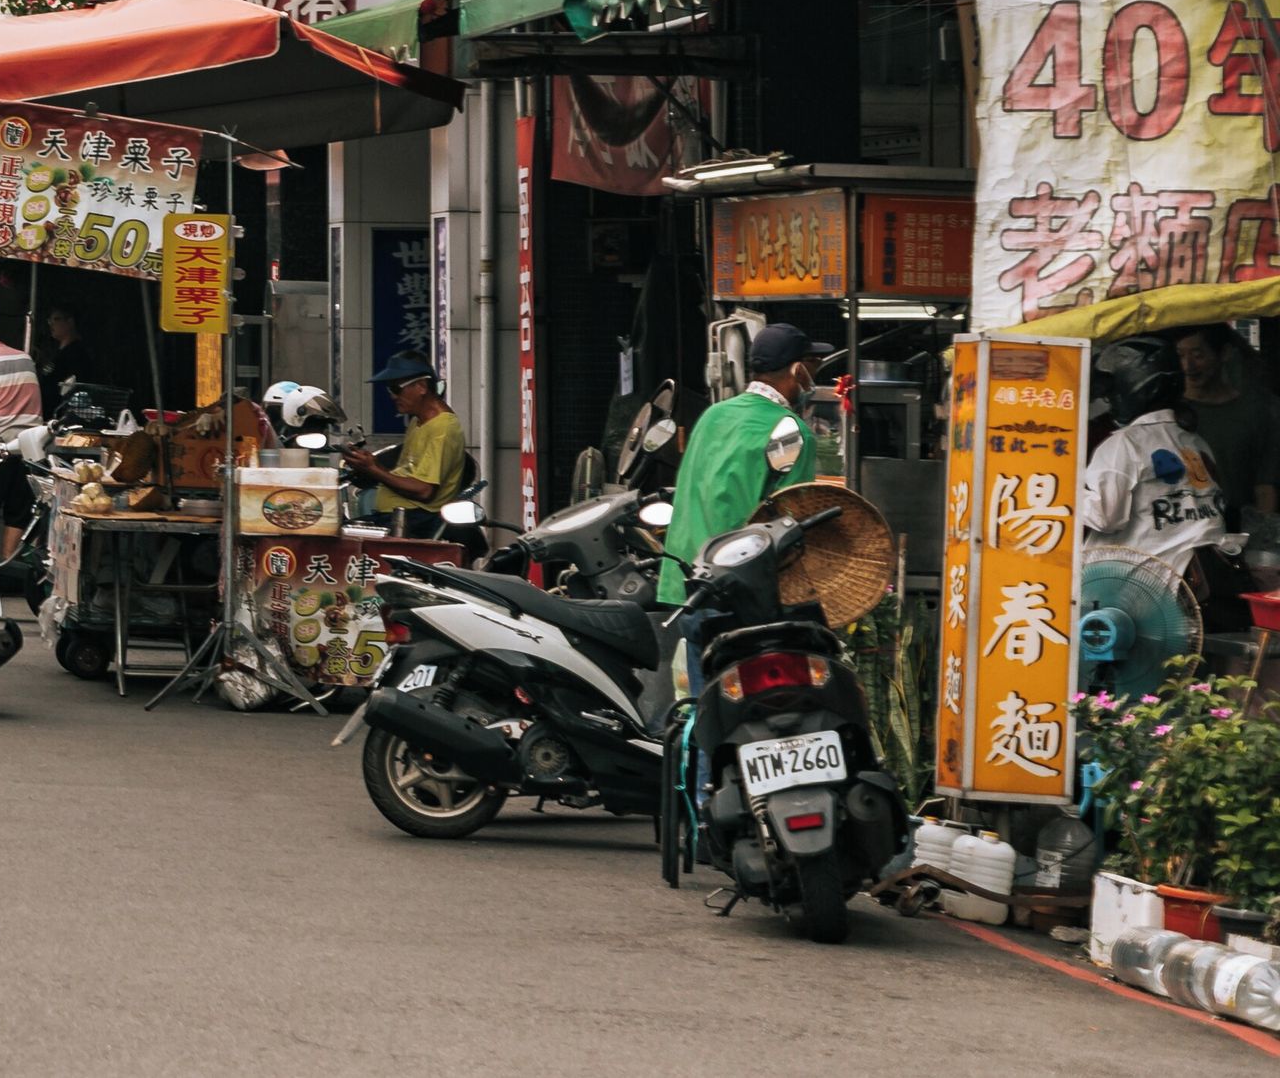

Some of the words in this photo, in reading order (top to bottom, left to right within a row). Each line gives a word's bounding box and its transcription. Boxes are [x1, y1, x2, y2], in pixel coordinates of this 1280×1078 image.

[37, 128, 197, 182] 天津栗子
[90, 183, 185, 215] 珍珠栗子
[53, 208, 79, 259] 一大袋
[181, 222, 217, 238] 現炒
[174, 245, 222, 326] 天津栗子
[993, 386, 1076, 411] 40年老店
[989, 434, 1071, 457] 僅此一家
[302, 554, 381, 588] 天津
[982, 472, 1075, 776] 陽春麵
[326, 627, 350, 675] 一大袋
[746, 744, 841, 784] MTM-2660
